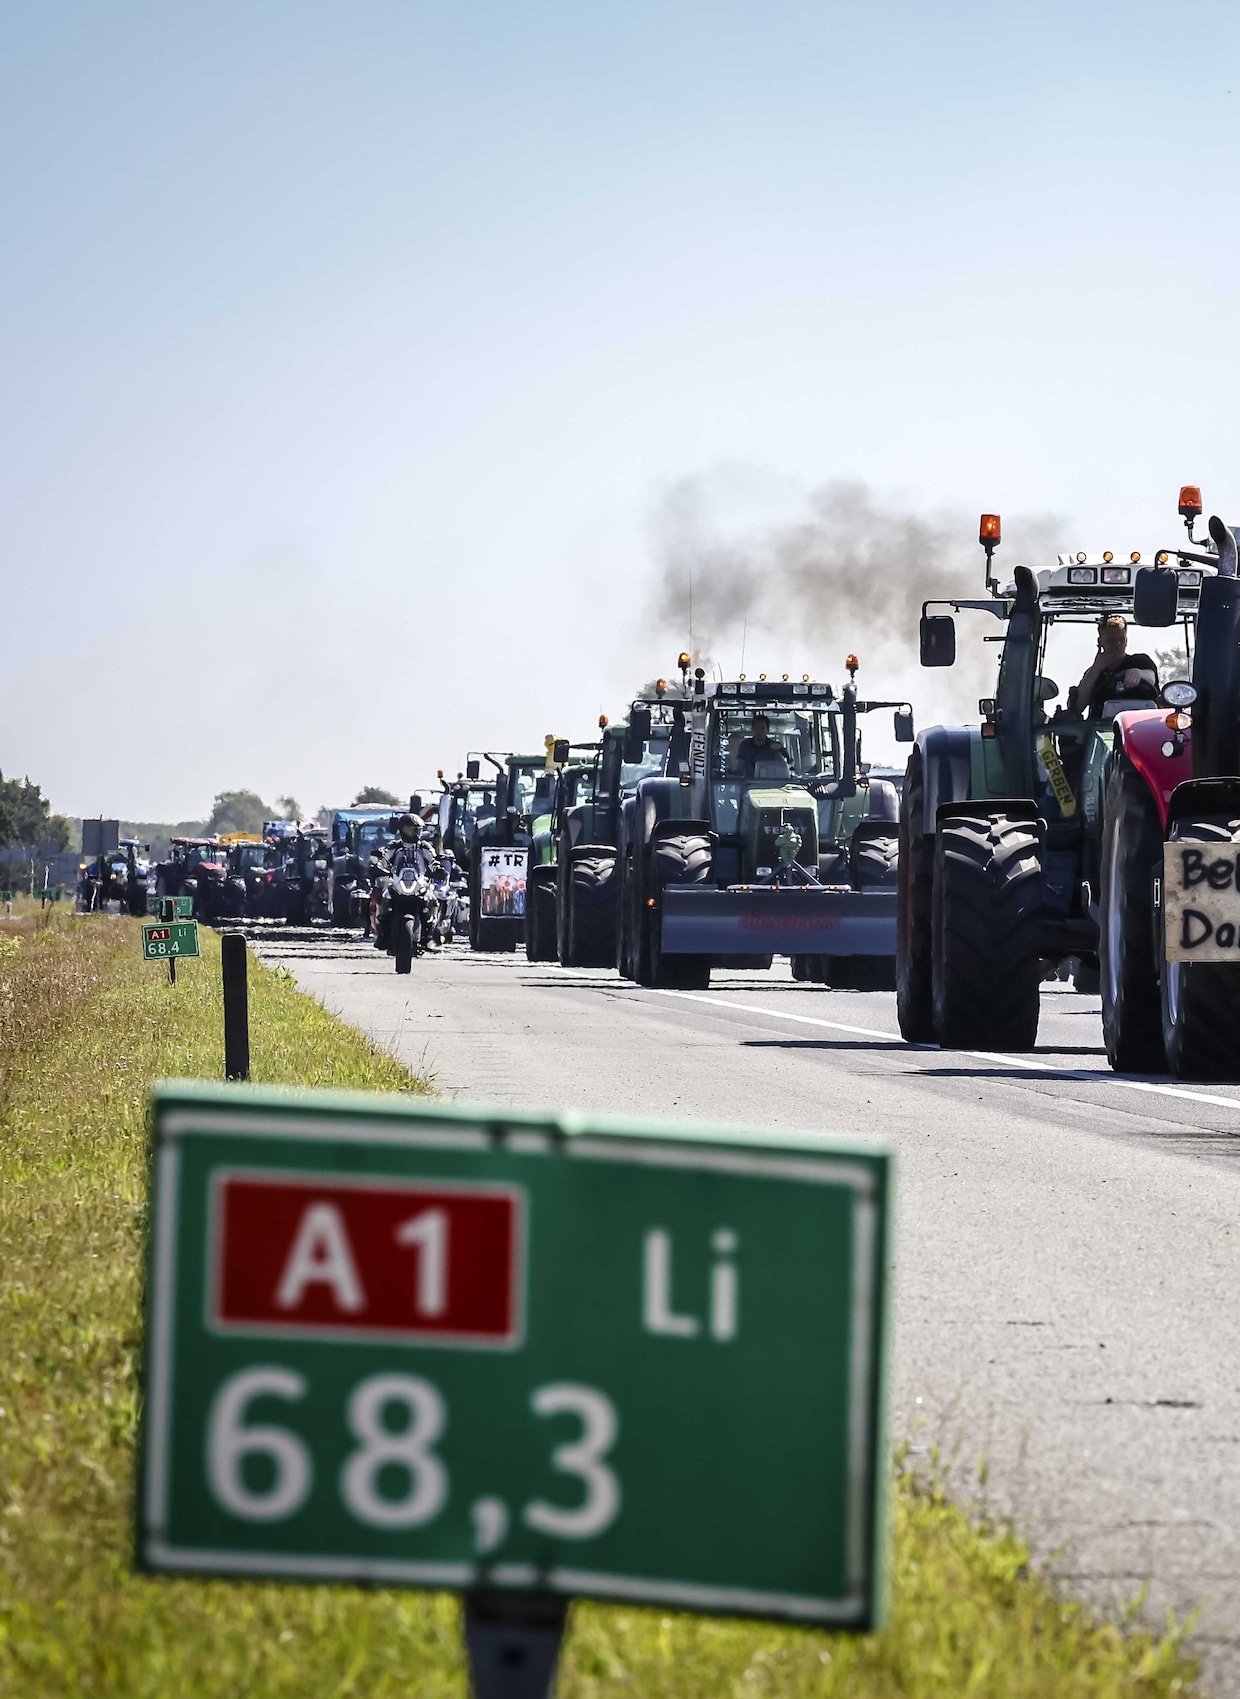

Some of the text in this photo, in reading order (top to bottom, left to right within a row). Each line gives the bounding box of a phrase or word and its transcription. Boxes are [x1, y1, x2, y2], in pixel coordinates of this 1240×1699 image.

[1042, 750, 1073, 805] GERBEN
[148, 941, 180, 955] 68,4
[151, 928, 187, 940] A1 Li
[275, 1200, 740, 1342] A1 Li
[205, 1364, 622, 1553] 68,3
